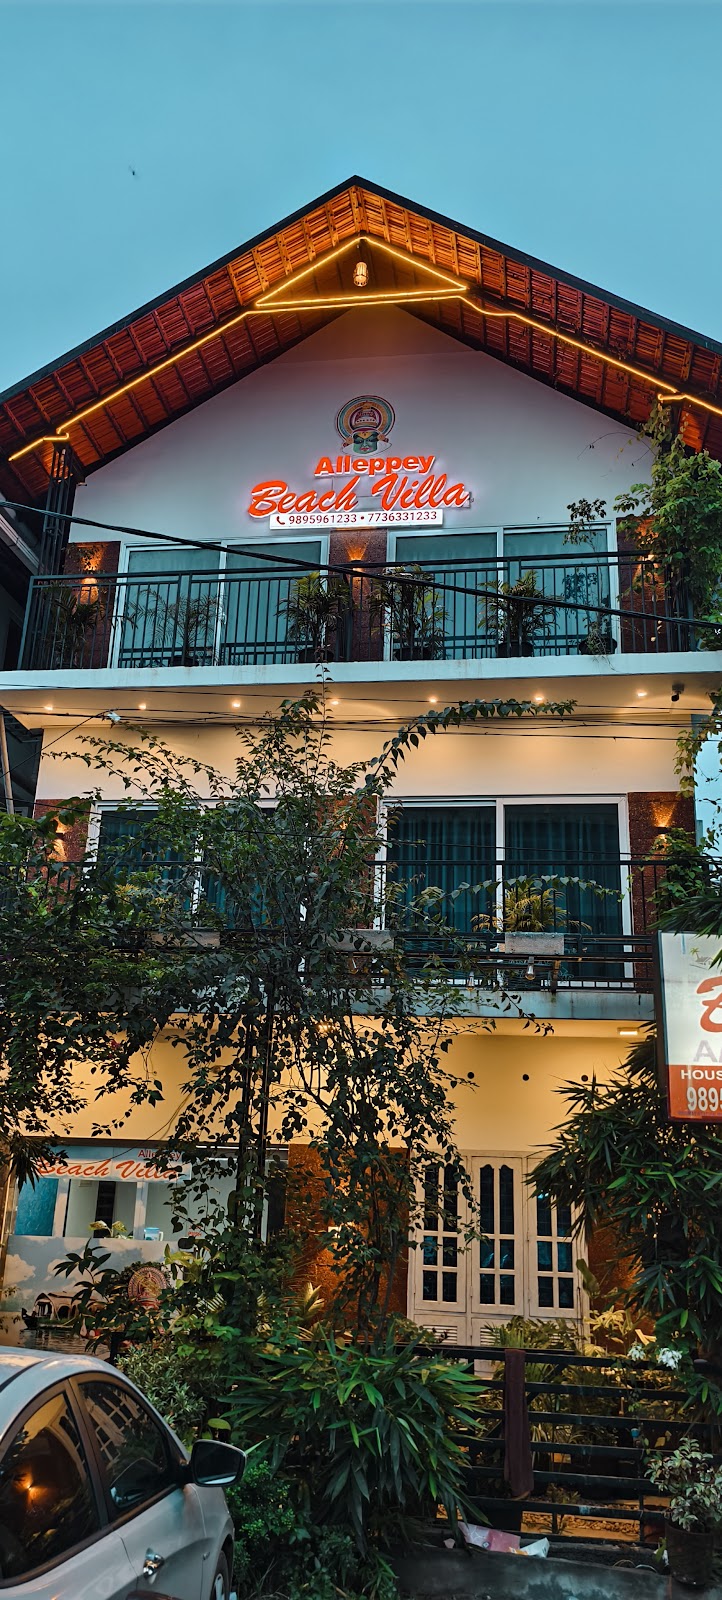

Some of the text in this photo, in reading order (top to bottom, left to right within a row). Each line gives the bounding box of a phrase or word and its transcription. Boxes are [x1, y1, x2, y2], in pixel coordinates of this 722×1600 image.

[314, 455, 435, 476] Alleppey
[249, 473, 470, 517] Beach Villa
[288, 511, 437, 525] 9895961233 7736331233
[686, 1086, 722, 1112] 989
